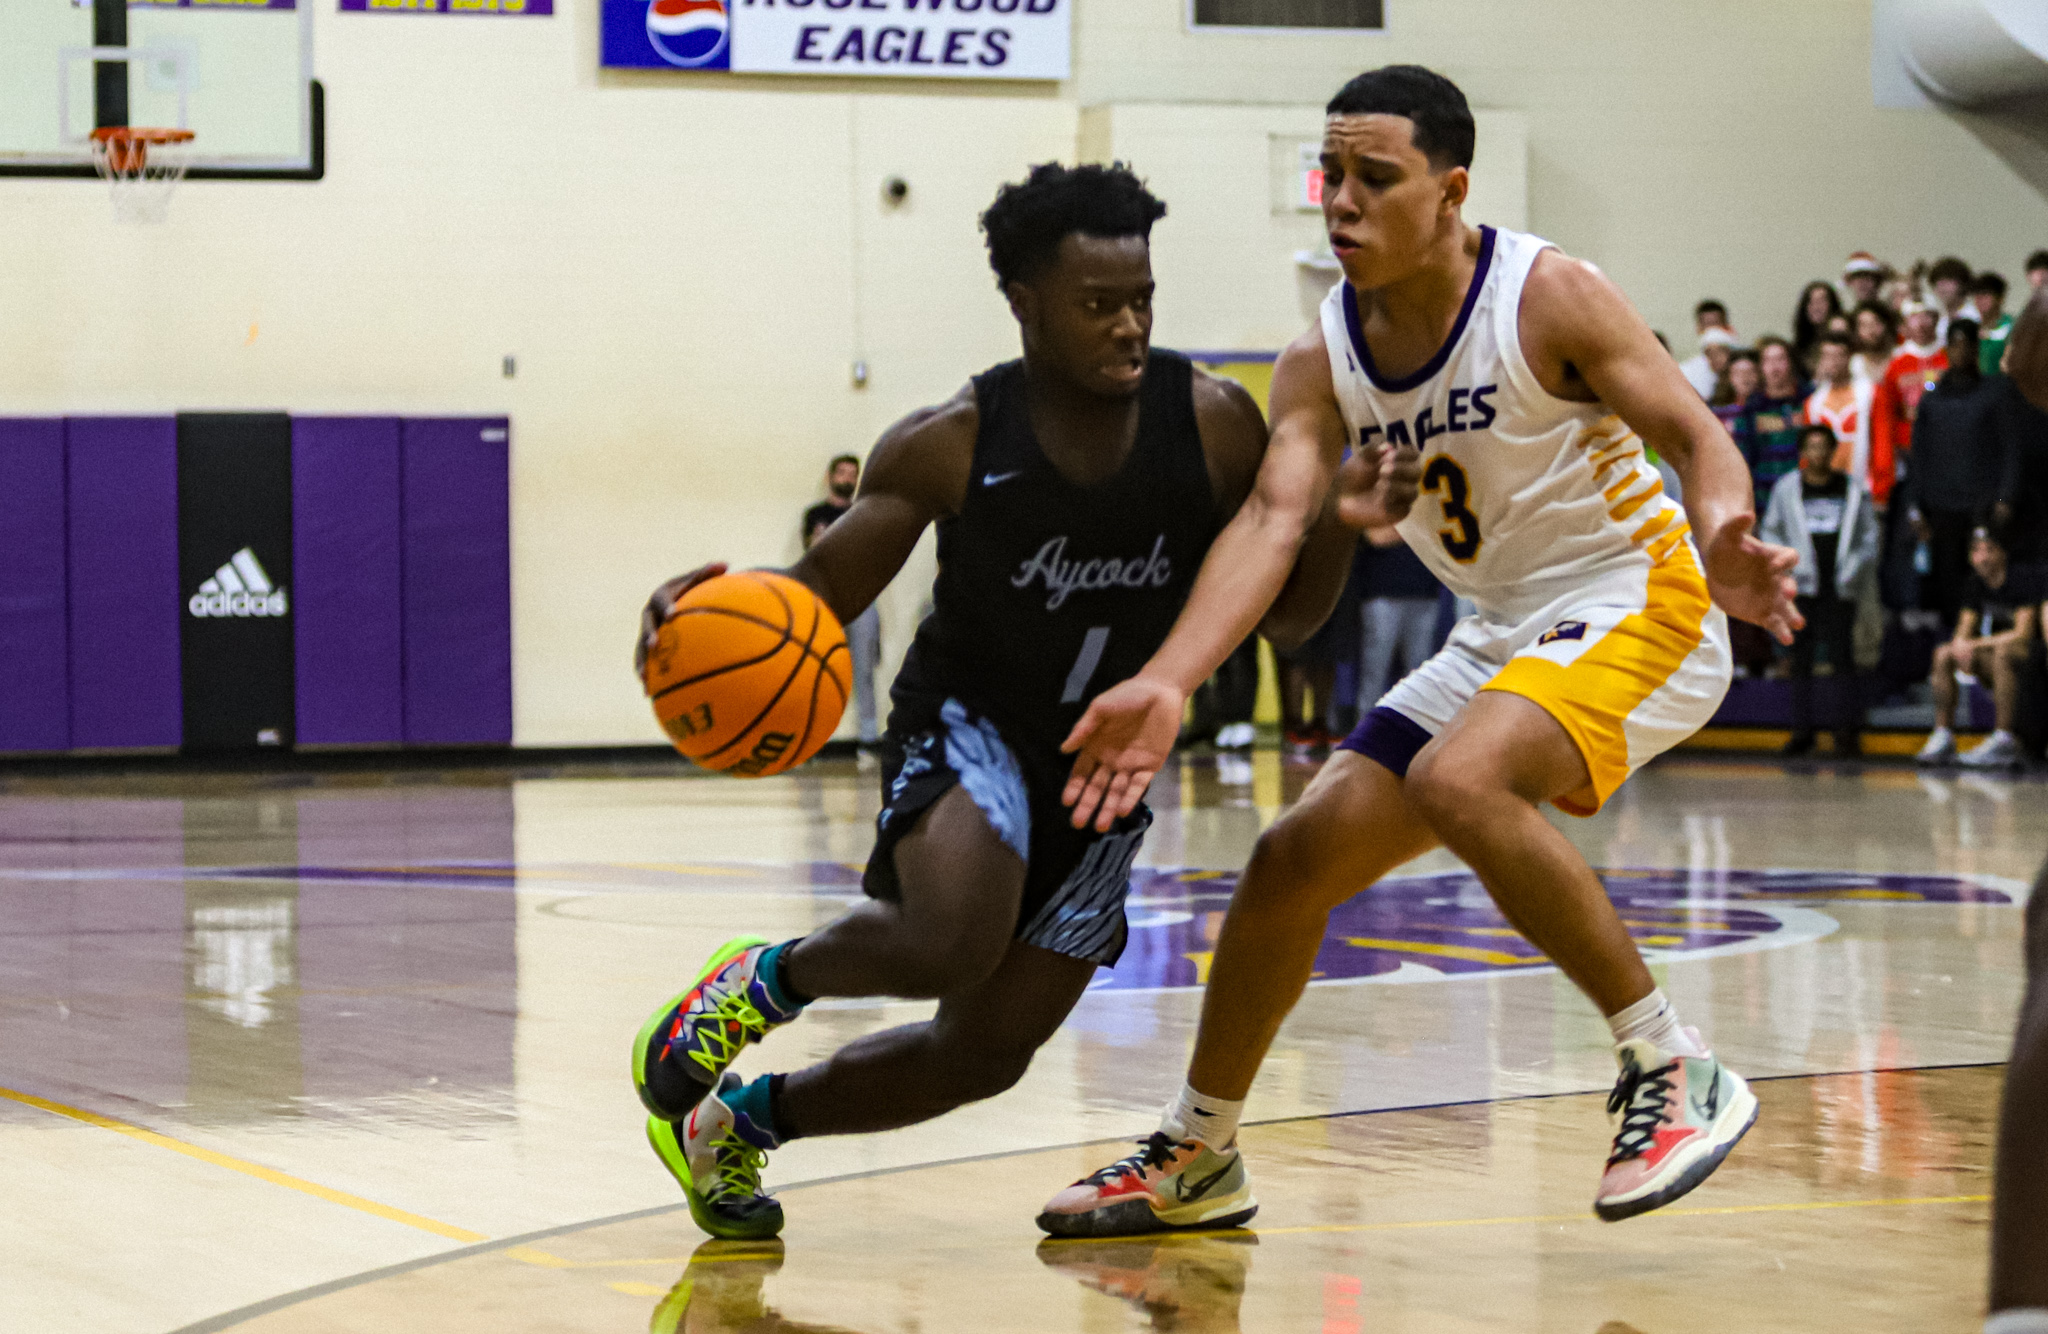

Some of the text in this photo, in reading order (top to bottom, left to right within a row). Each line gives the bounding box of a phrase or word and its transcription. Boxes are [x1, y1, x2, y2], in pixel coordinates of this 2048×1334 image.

[793, 25, 1012, 67] EAGLES
[1419, 453, 1484, 565] 3
[188, 591, 288, 618] adidas
[1010, 533, 1171, 611] Aycock
[1060, 626, 1111, 704] 1
